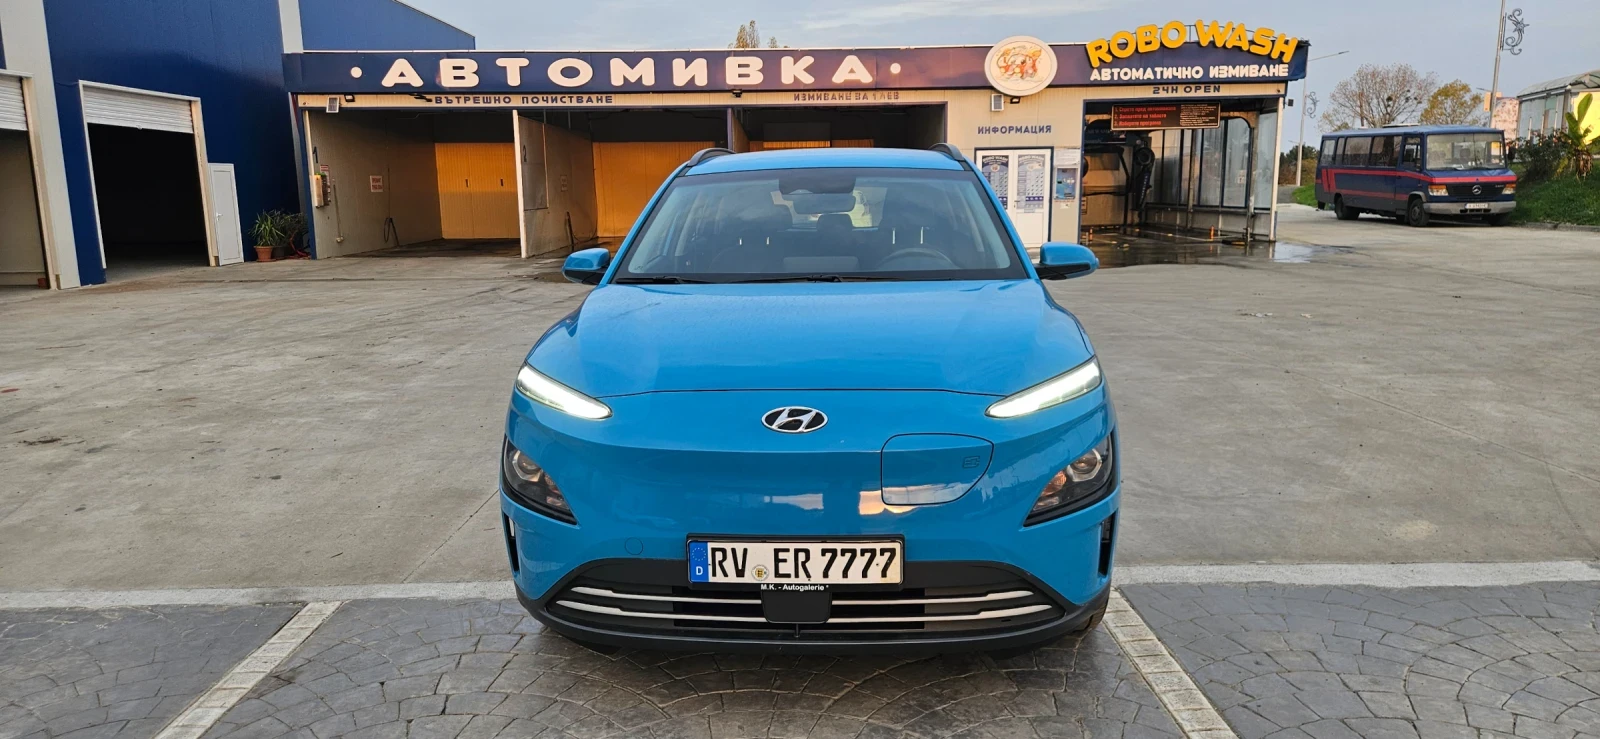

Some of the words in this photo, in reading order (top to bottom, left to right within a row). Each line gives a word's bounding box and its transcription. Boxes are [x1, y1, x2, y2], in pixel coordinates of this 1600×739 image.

[1086, 20, 1187, 68] ROBO
[1195, 19, 1299, 63] WASH
[381, 54, 873, 88] АВТОМИВКА
[1090, 66, 1204, 81] АВТОМАТИЧНО
[1209, 64, 1289, 79] ИЗМИВАНЕ
[1152, 86, 1178, 95] 24H
[1184, 85, 1221, 94] OPEN
[434, 96, 512, 105] ВЪТРЕШНО
[521, 95, 613, 105] ПОЧИСТВАНЕ
[977, 125, 1052, 135] ИНФОРМАЦИЯ
[710, 547, 748, 578] RV
[773, 547, 811, 579] ER
[820, 547, 897, 579] 7777
[695, 566, 703, 576] D
[782, 583, 825, 592] Autogalerie
